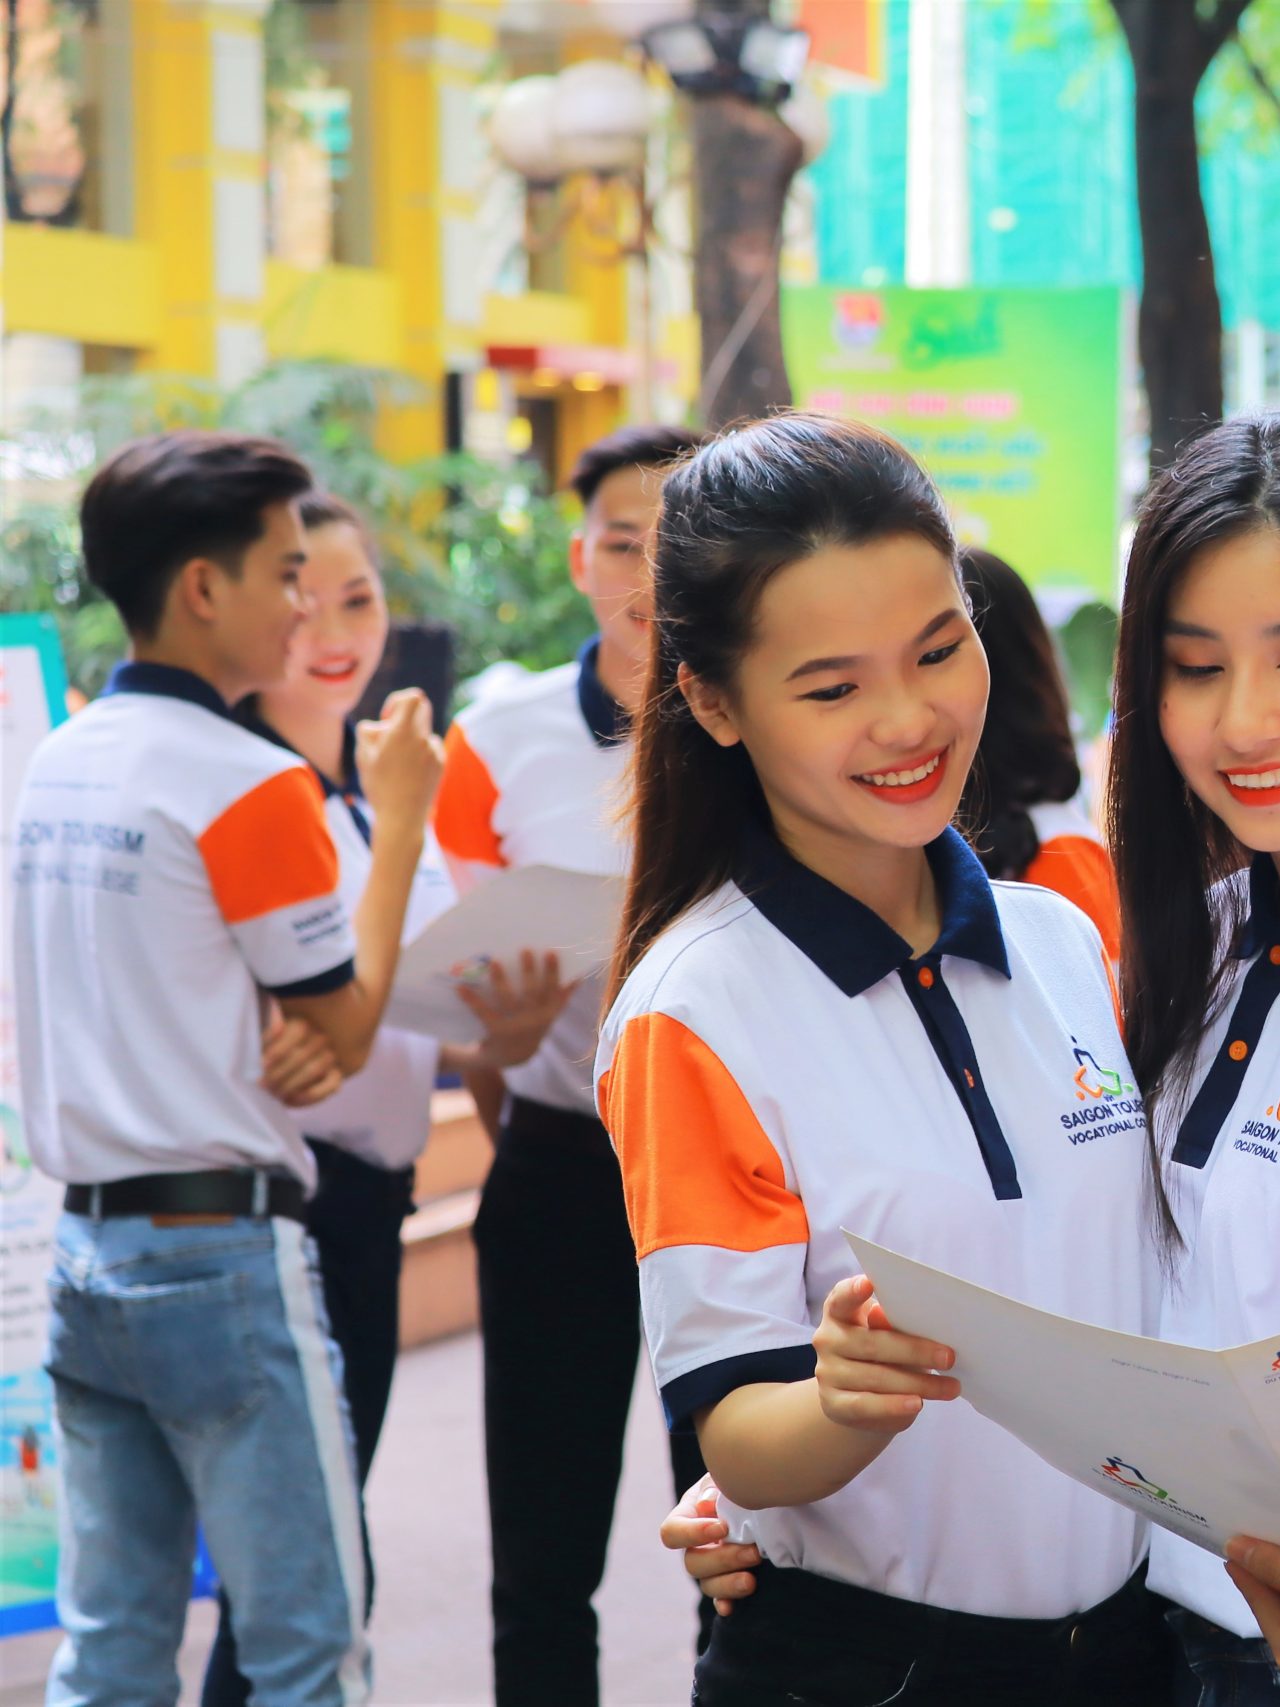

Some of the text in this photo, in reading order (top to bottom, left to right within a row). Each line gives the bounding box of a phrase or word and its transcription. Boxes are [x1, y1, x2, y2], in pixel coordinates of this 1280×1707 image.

[1060, 1104, 1115, 1130] SAIGON
[1112, 1099, 1145, 1115] TOUR
[1067, 1119, 1136, 1146] VOCATIONAL
[1241, 1120, 1280, 1143] SAIGON
[1233, 1138, 1278, 1163] VOCATIONAL
